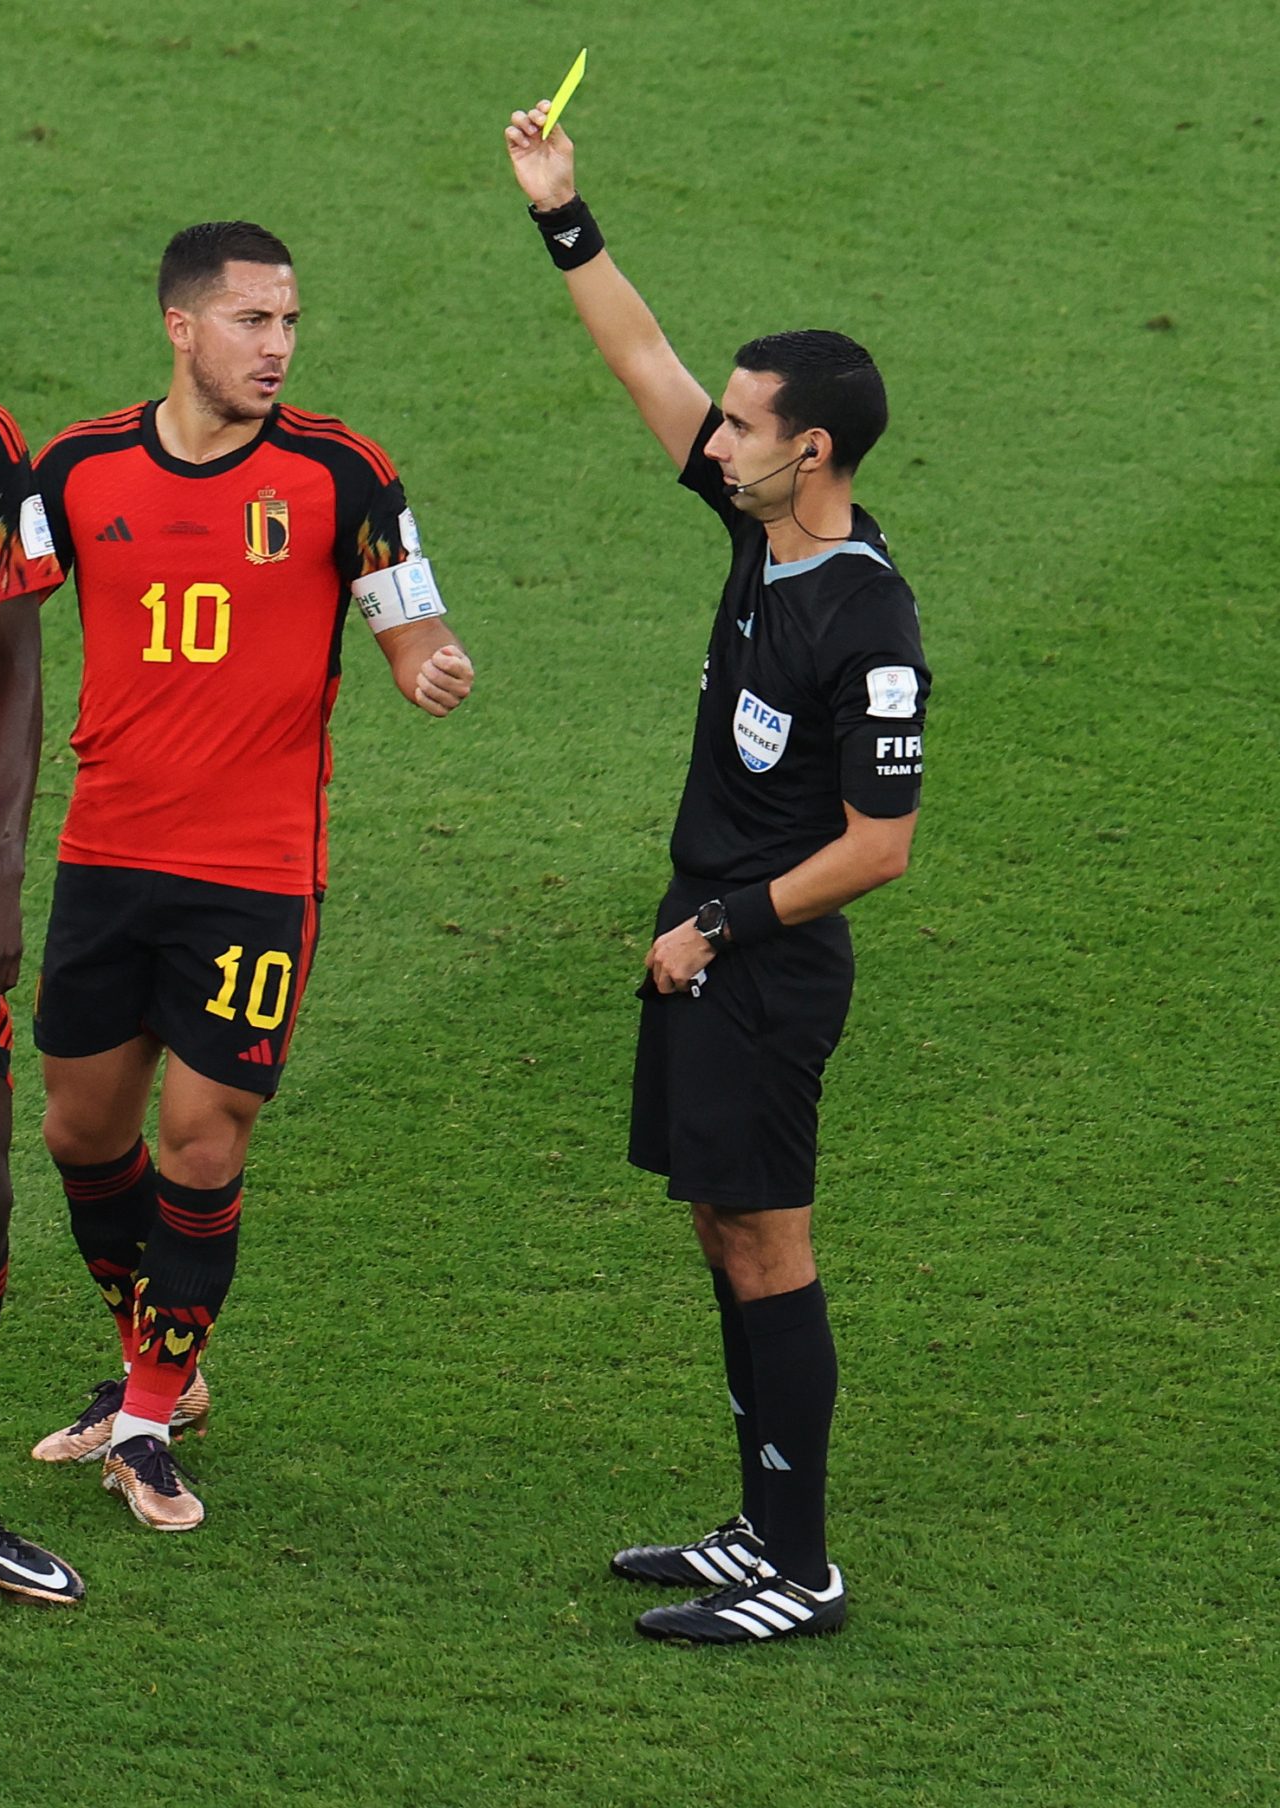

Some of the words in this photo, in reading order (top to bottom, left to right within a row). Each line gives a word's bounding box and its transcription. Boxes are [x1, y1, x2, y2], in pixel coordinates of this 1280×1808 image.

[139, 582, 231, 663] 10
[742, 697, 781, 733] FIFA
[738, 723, 779, 752] REFEREE
[876, 764, 911, 776] TEAM
[205, 945, 292, 1030] 10
